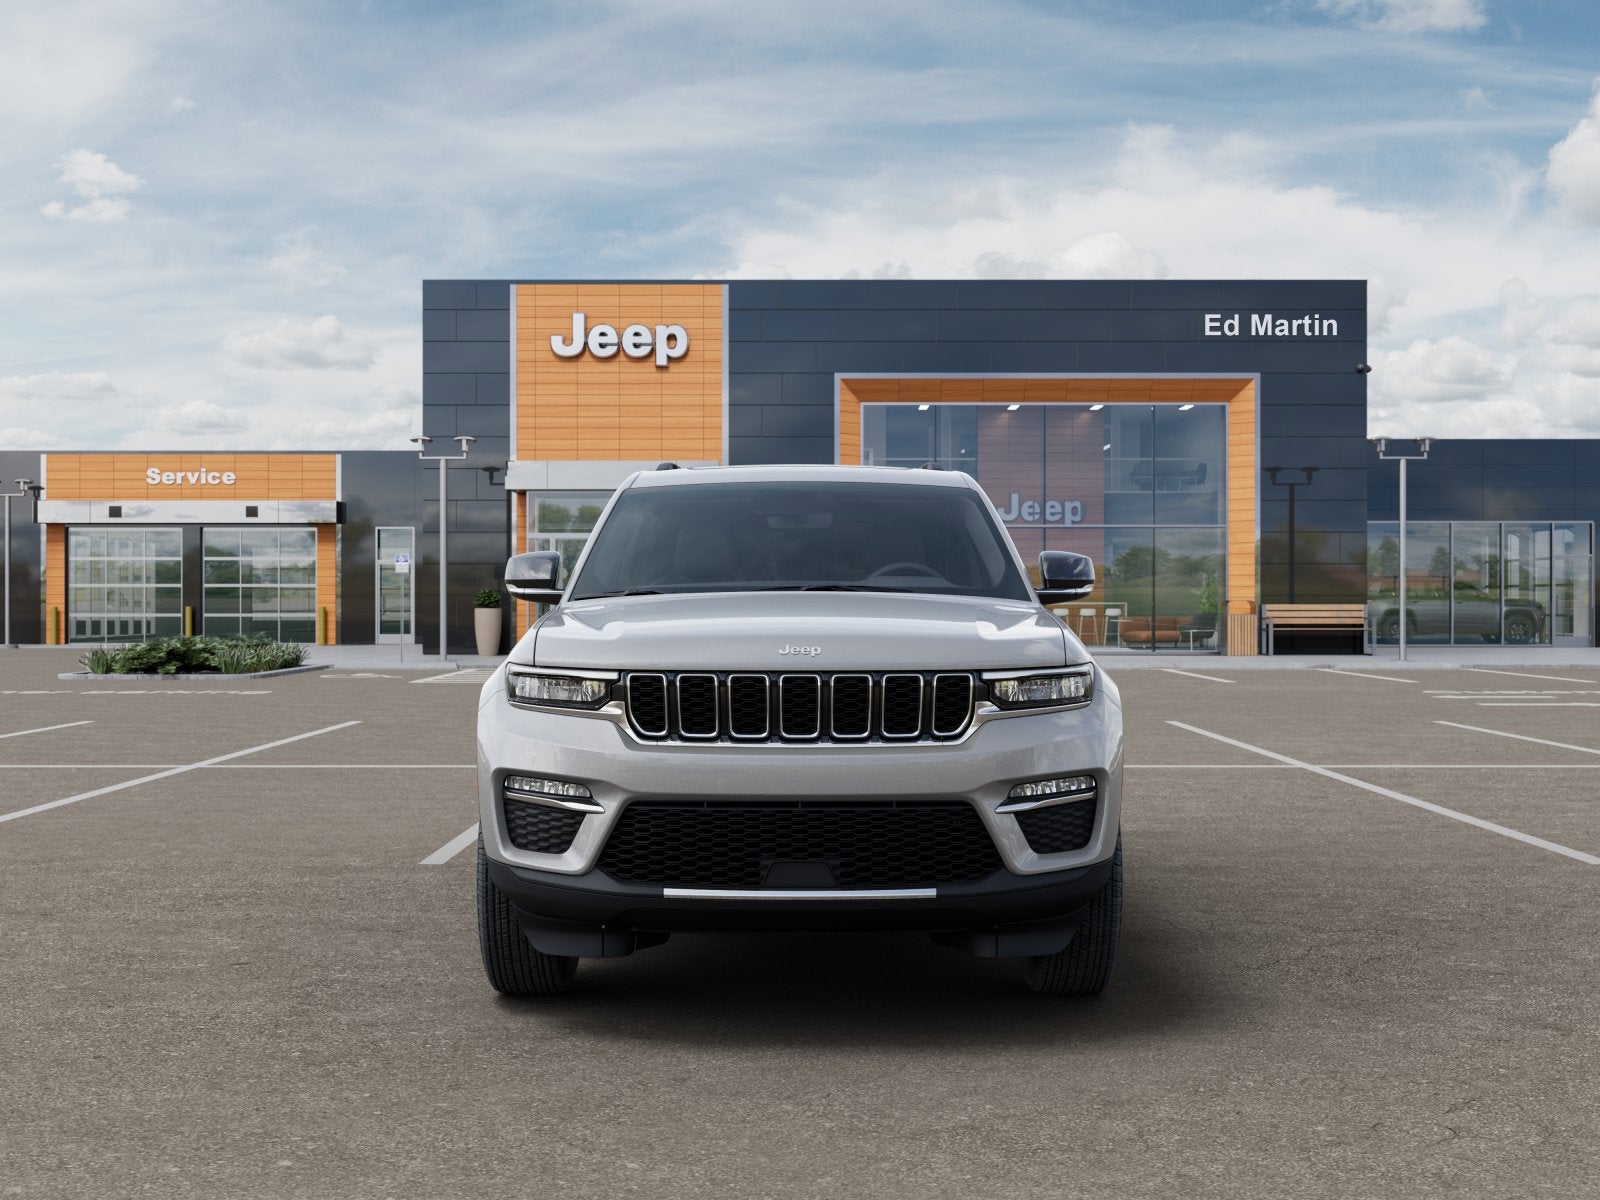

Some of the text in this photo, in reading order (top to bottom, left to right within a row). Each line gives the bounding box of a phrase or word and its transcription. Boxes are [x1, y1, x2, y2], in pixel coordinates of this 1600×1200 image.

[1204, 313, 1338, 336] Ed Martin
[550, 312, 689, 367] Jeep
[146, 467, 237, 486] Service
[997, 493, 1083, 526] Jeep
[778, 644, 822, 657] Jeep
